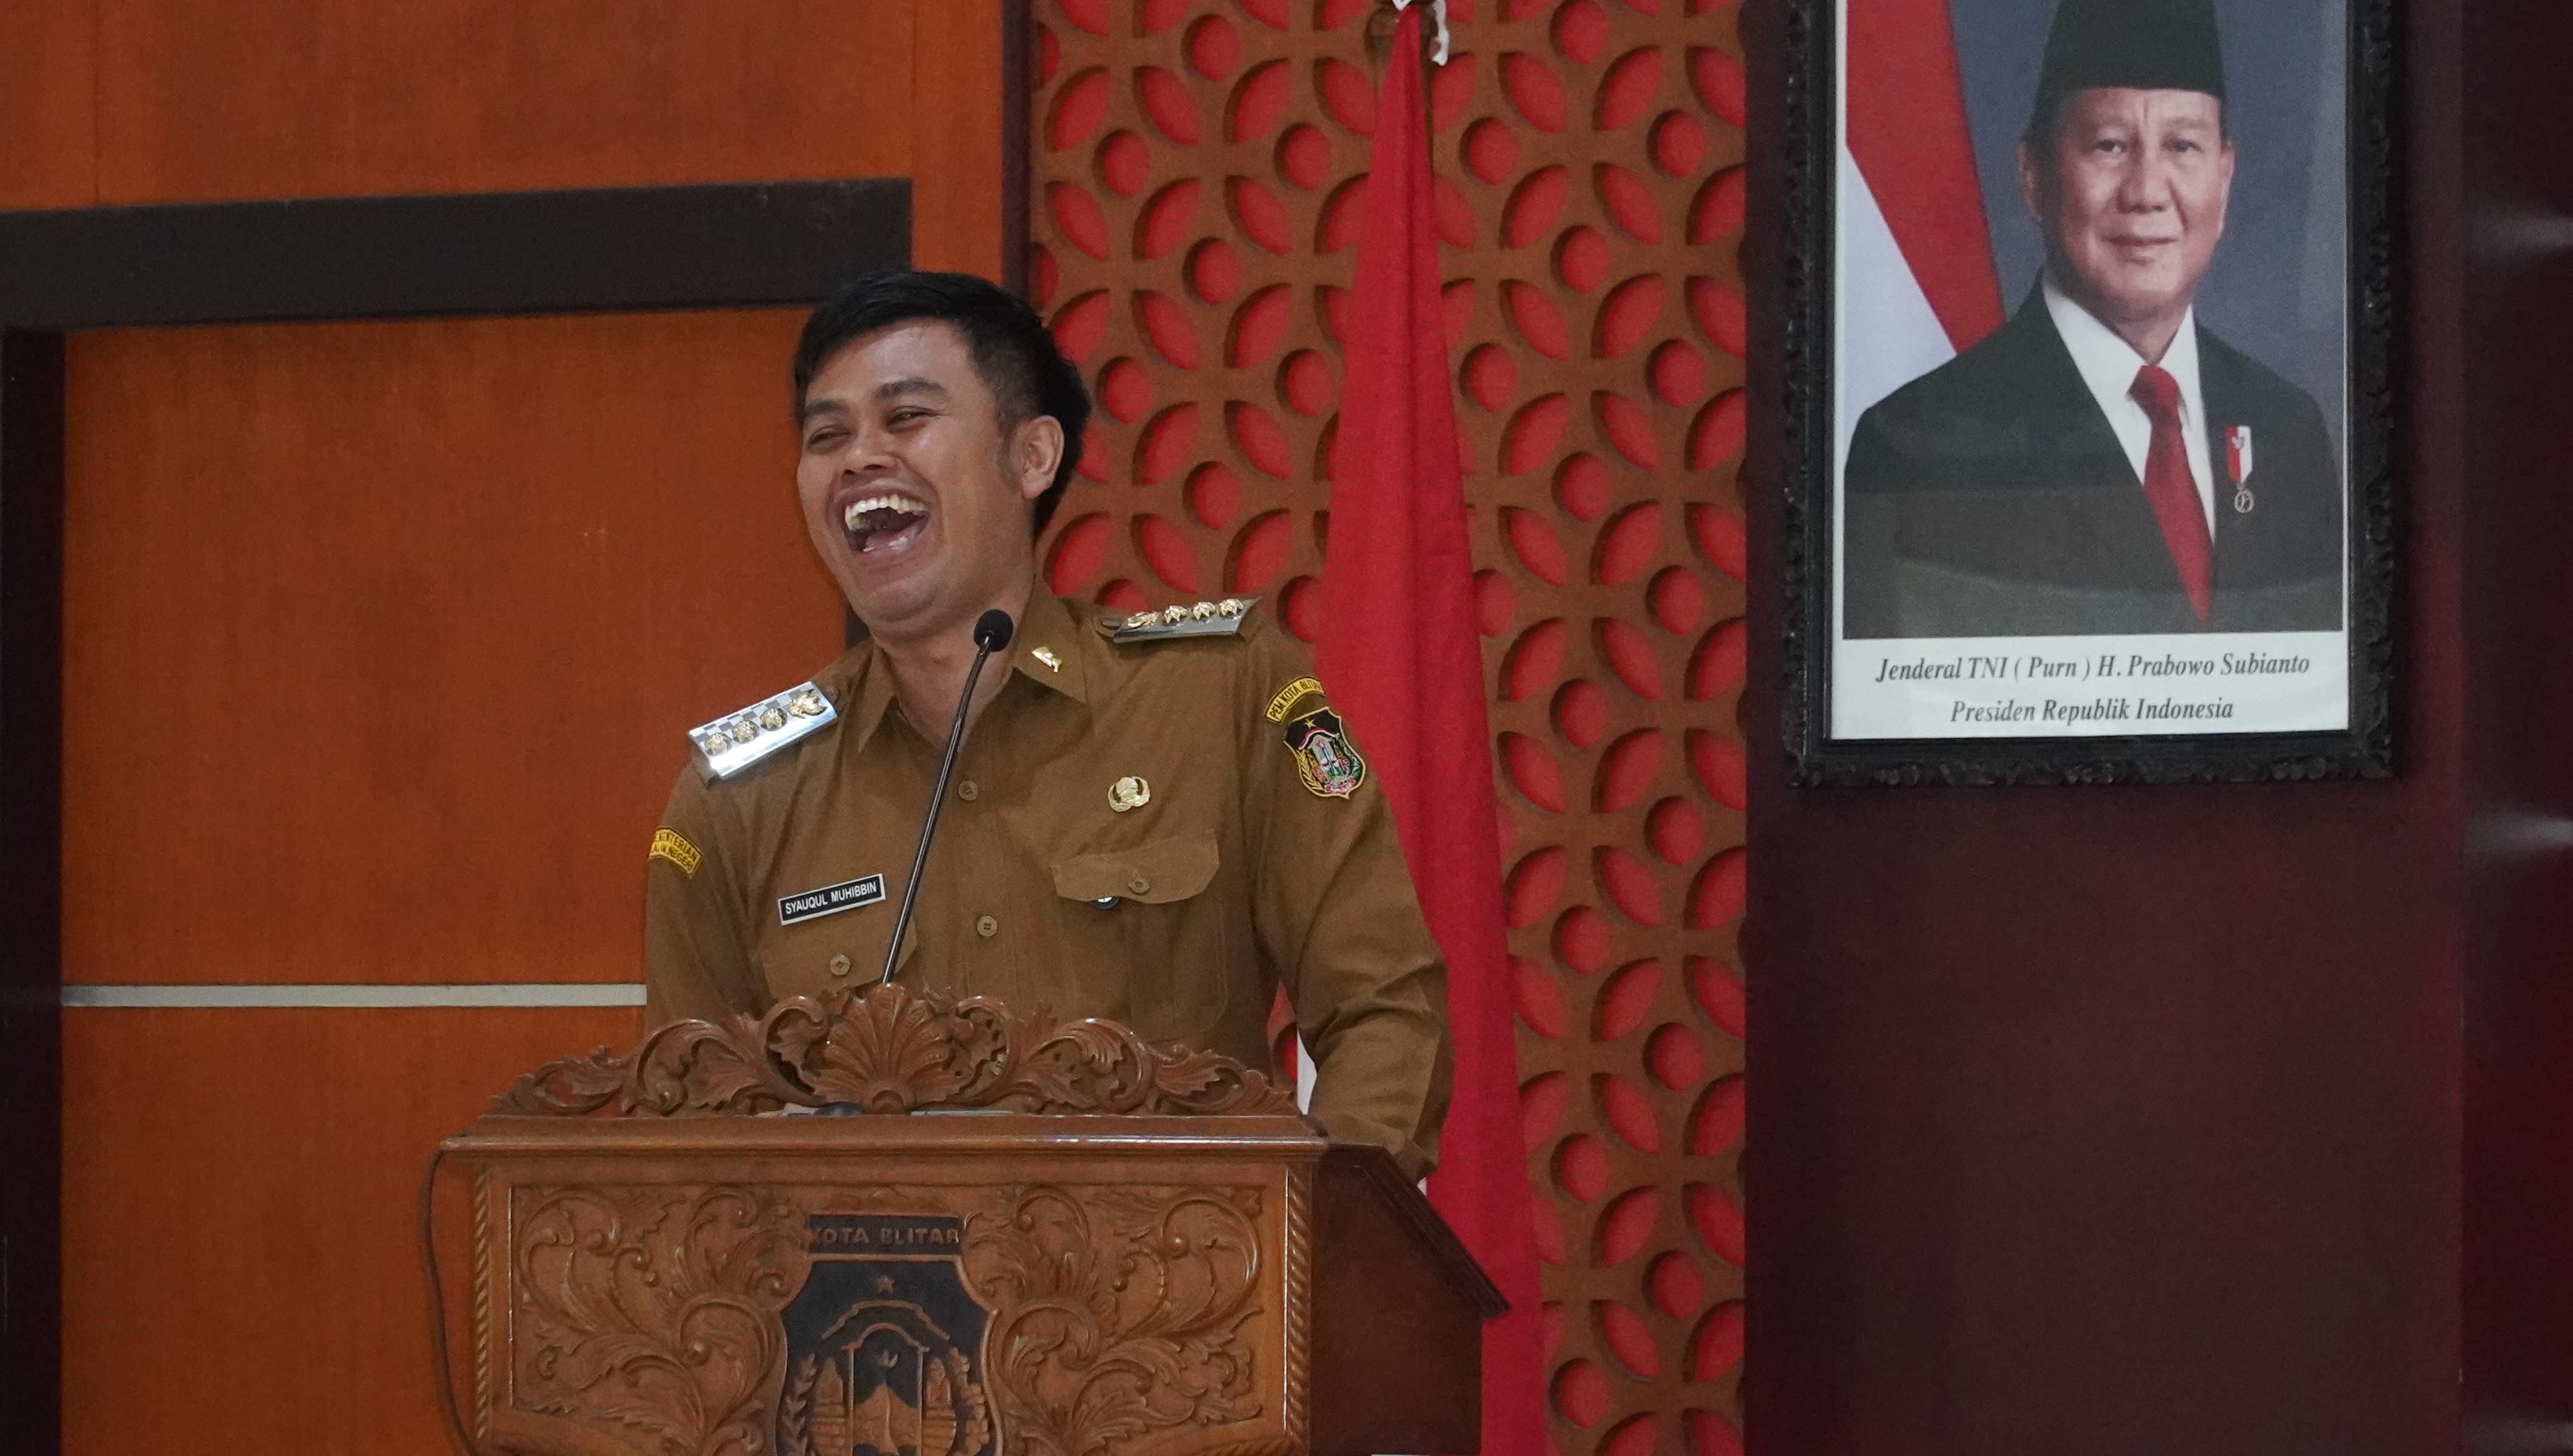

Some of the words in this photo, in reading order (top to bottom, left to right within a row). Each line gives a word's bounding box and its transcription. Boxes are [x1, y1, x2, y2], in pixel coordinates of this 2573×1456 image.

[1875, 656, 1963, 682] Jenderal
[1968, 656, 2009, 679] TNI
[2096, 655, 2122, 677] H.
[2126, 653, 2215, 677] Prabowo
[2220, 652, 2310, 675] Subianto
[1279, 684, 1302, 704] KOTA
[1950, 699, 2036, 723] Presiden
[2041, 698, 2131, 727] Republik
[2135, 696, 2234, 720] Indonesia
[785, 893, 828, 915] SYAUQUL
[830, 881, 877, 903] MUHIBBIN
